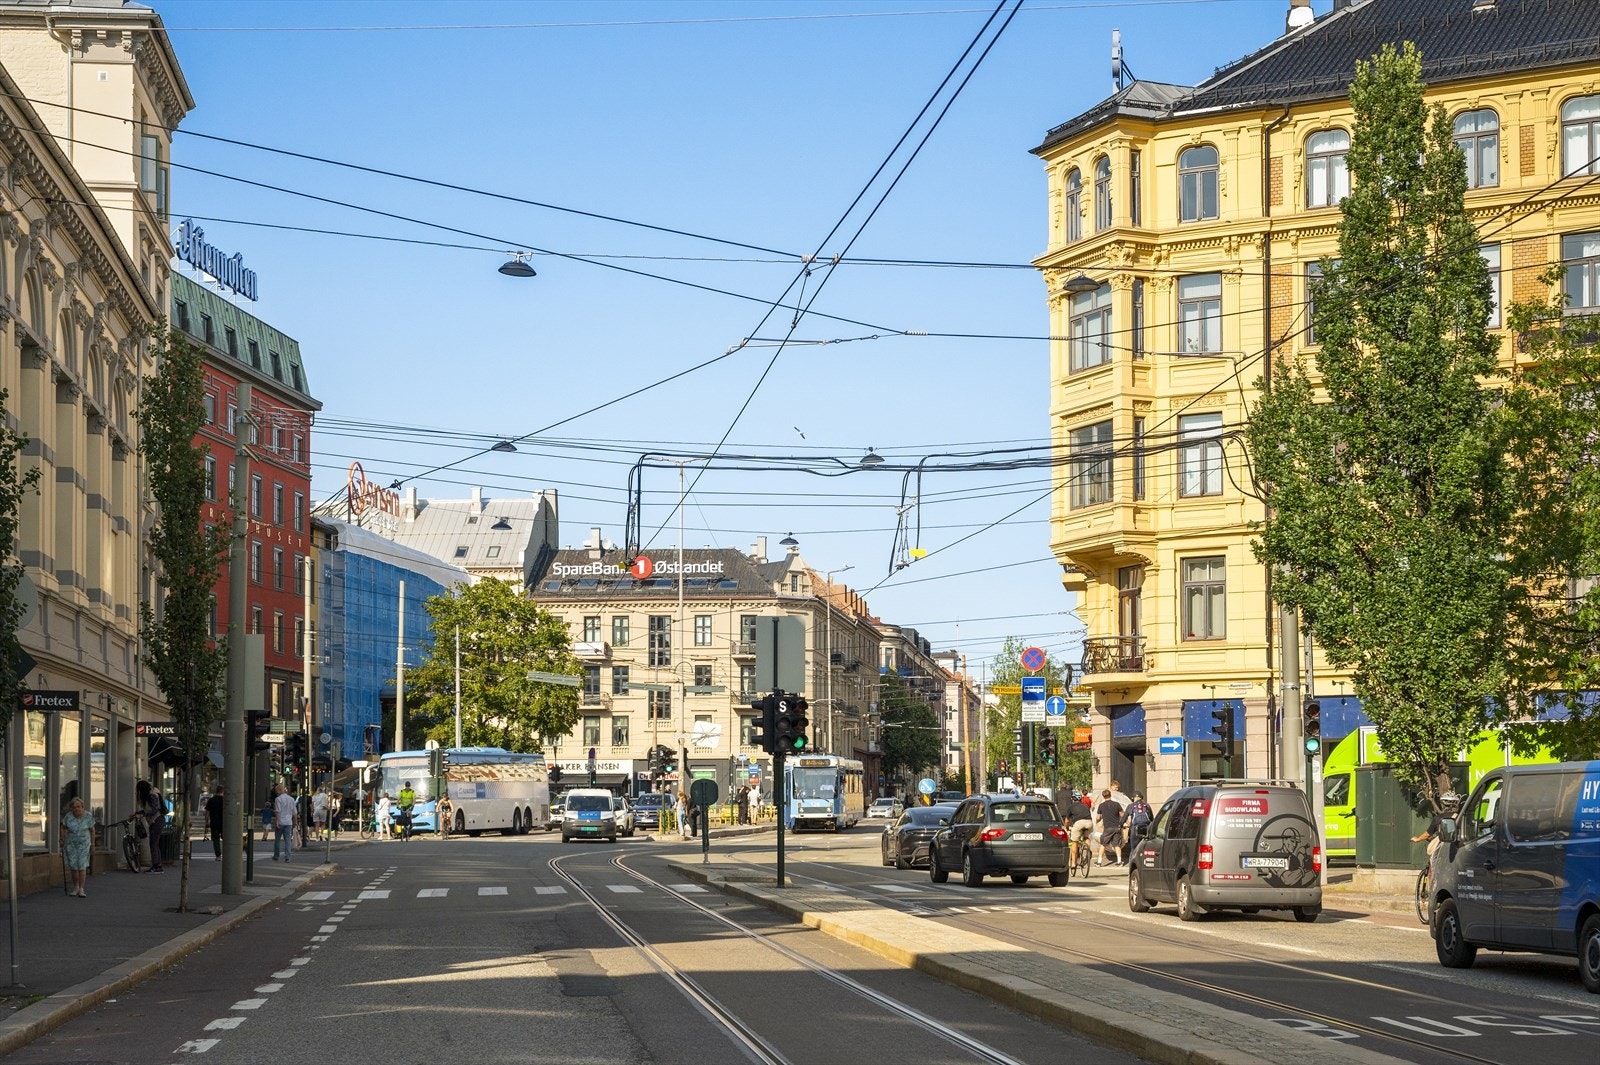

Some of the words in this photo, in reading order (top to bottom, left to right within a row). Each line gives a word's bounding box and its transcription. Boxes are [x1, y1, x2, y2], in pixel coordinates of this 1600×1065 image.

[637, 559, 645, 575] 1
[34, 694, 73, 707] Fretex
[779, 700, 787, 713] S
[145, 725, 175, 734] Fretex
[557, 762, 582, 771] AKER
[1248, 858, 1261, 867] WRA
[1263, 858, 1284, 867] 77904
